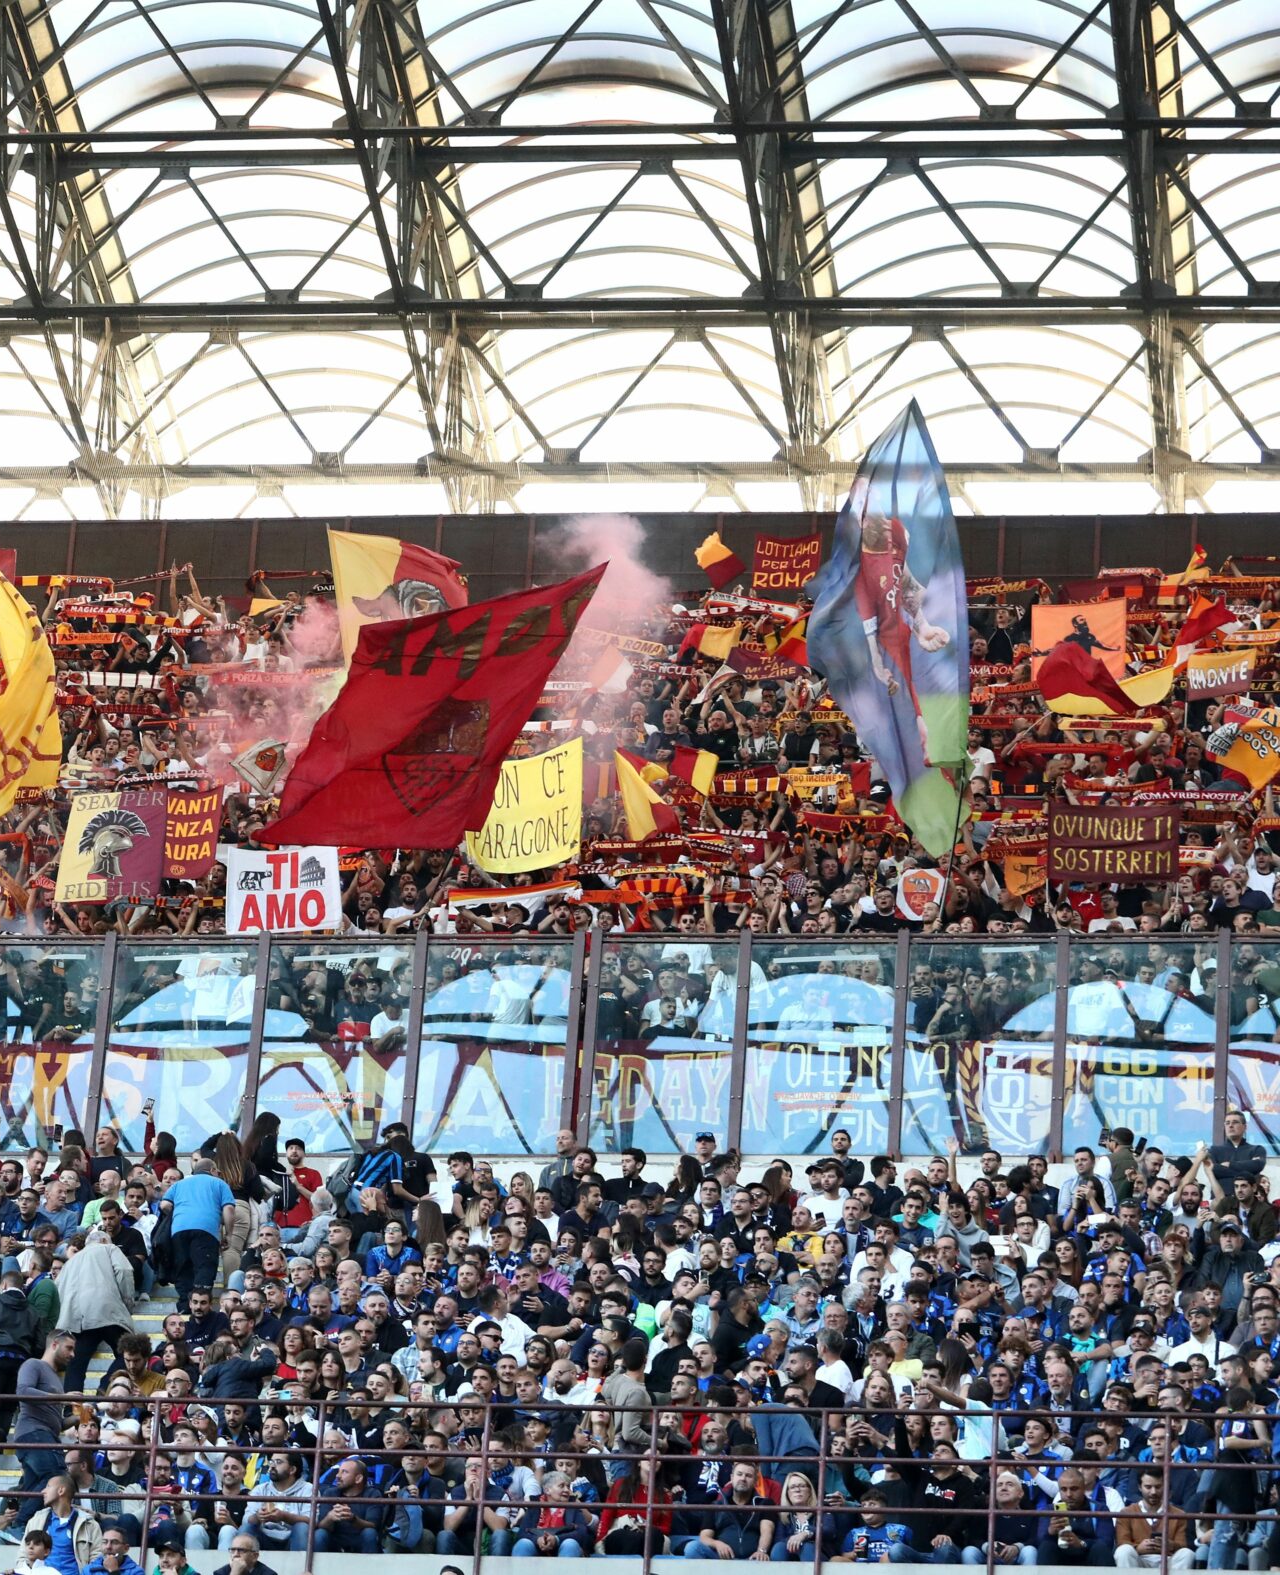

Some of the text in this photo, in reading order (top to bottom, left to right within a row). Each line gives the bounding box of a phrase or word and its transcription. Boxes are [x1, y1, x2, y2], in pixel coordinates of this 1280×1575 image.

[756, 541, 819, 558] LOTTIAMO
[761, 559, 811, 570] PER LA
[71, 605, 133, 614] MAGICA ROMA
[494, 765, 520, 809] UN
[76, 791, 165, 812] SEMPER
[167, 794, 218, 816] VANTI
[166, 820, 214, 837] ENZA
[1053, 814, 1173, 842] OVUNQUE TI
[266, 852, 299, 890] TI
[64, 880, 152, 901] FIDELIS
[237, 889, 327, 932] AMO
[1103, 1049, 1157, 1076] 66
[1100, 1077, 1164, 1105] CON
[1106, 1108, 1159, 1135] NOI
